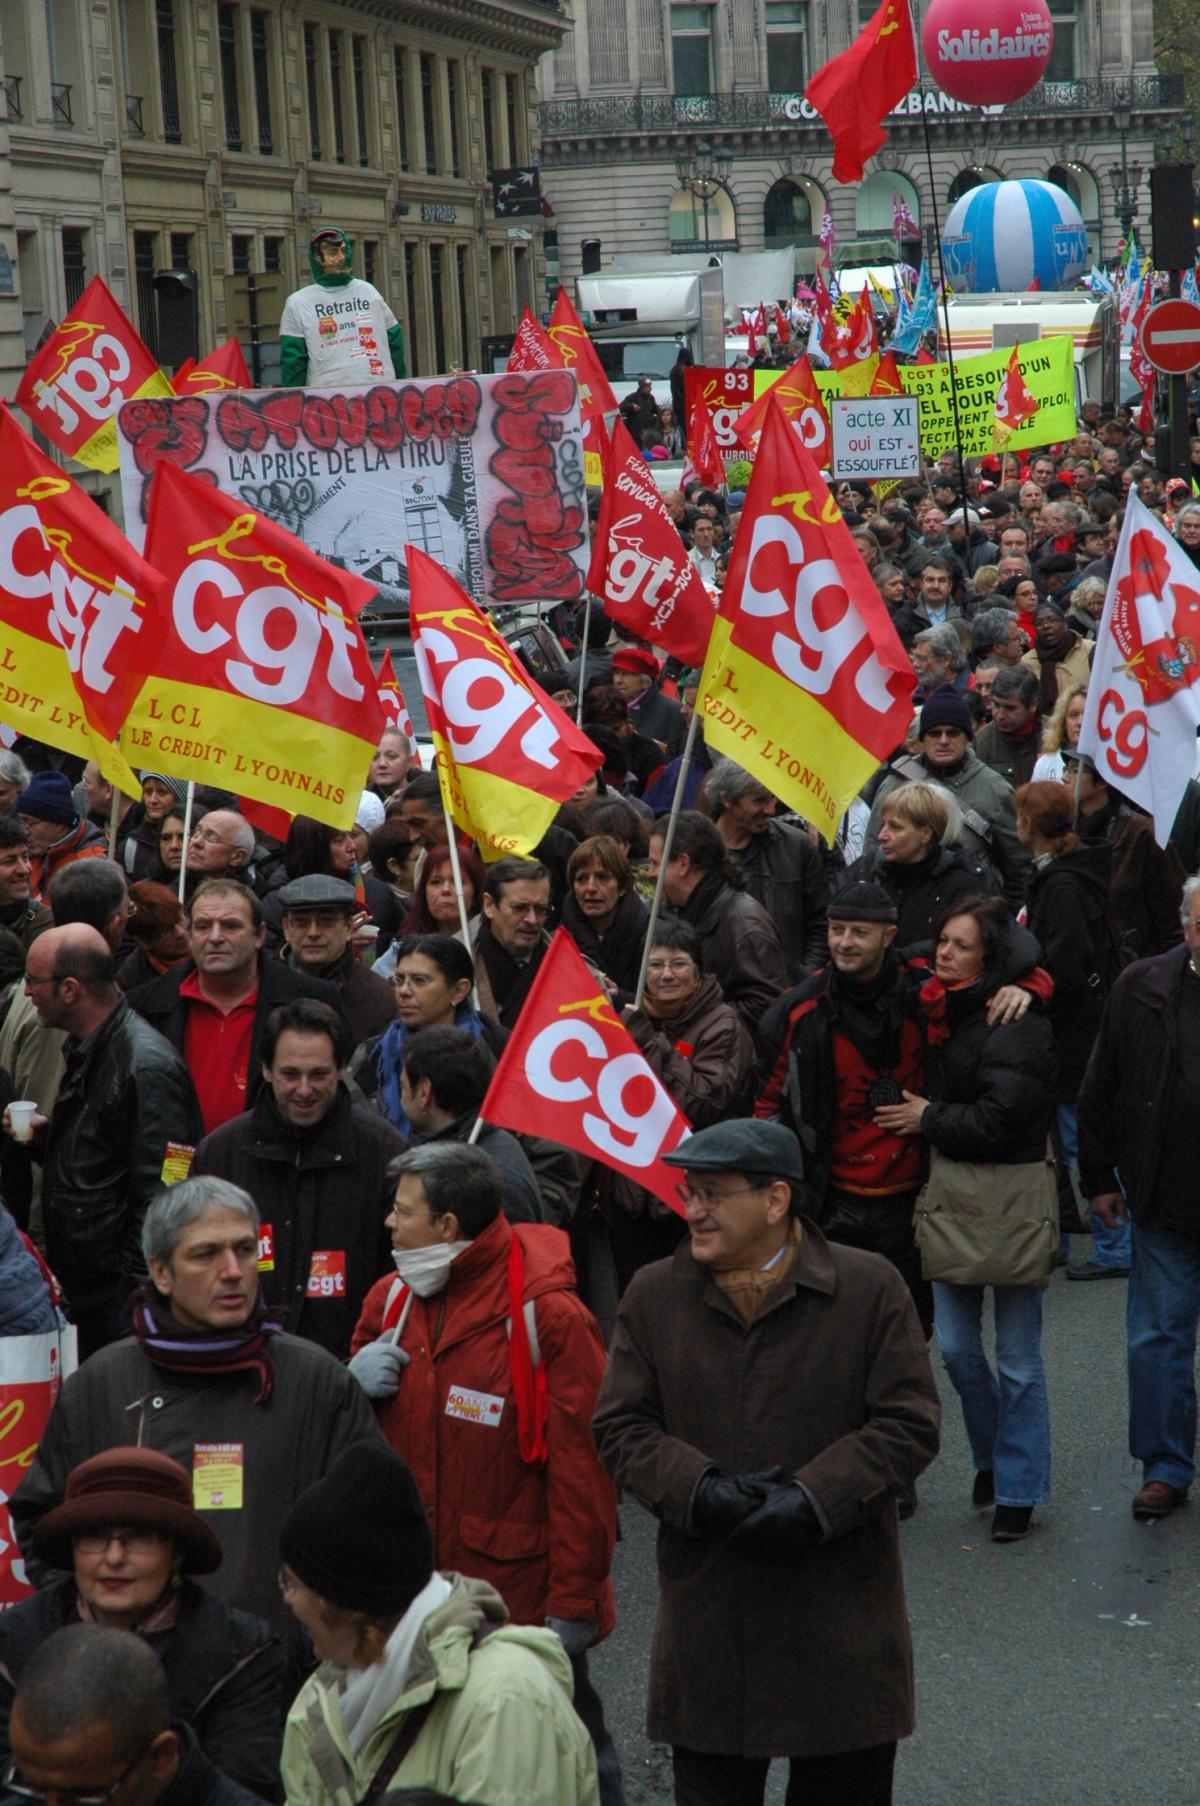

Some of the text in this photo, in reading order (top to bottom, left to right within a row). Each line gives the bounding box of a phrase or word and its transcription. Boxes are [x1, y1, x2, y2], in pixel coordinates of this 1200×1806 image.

[938, 26, 1050, 61] Solidaires
[315, 297, 370, 318] Retraite
[339, 321, 356, 330] ans
[724, 372, 749, 391] 93
[907, 369, 935, 380] CGT
[917, 383, 934, 396] 93
[940, 381, 950, 394] A
[1019, 356, 1051, 377] D'UN
[947, 390, 997, 411] POUR
[892, 407, 912, 427] XI
[879, 438, 904, 451] EST
[228, 439, 446, 481] LA PRISE DE LA TIRU
[837, 454, 918, 472] ESSOUFFLÉ?
[464, 486, 476, 504] TA
[465, 506, 480, 542] DANS
[0, 504, 143, 694] cgt
[172, 559, 365, 705] cgt
[131, 727, 346, 805] LE CREDIT LYONNAIS
[524, 1018, 692, 1168] cg
[307, 1272, 344, 1296] cgt
